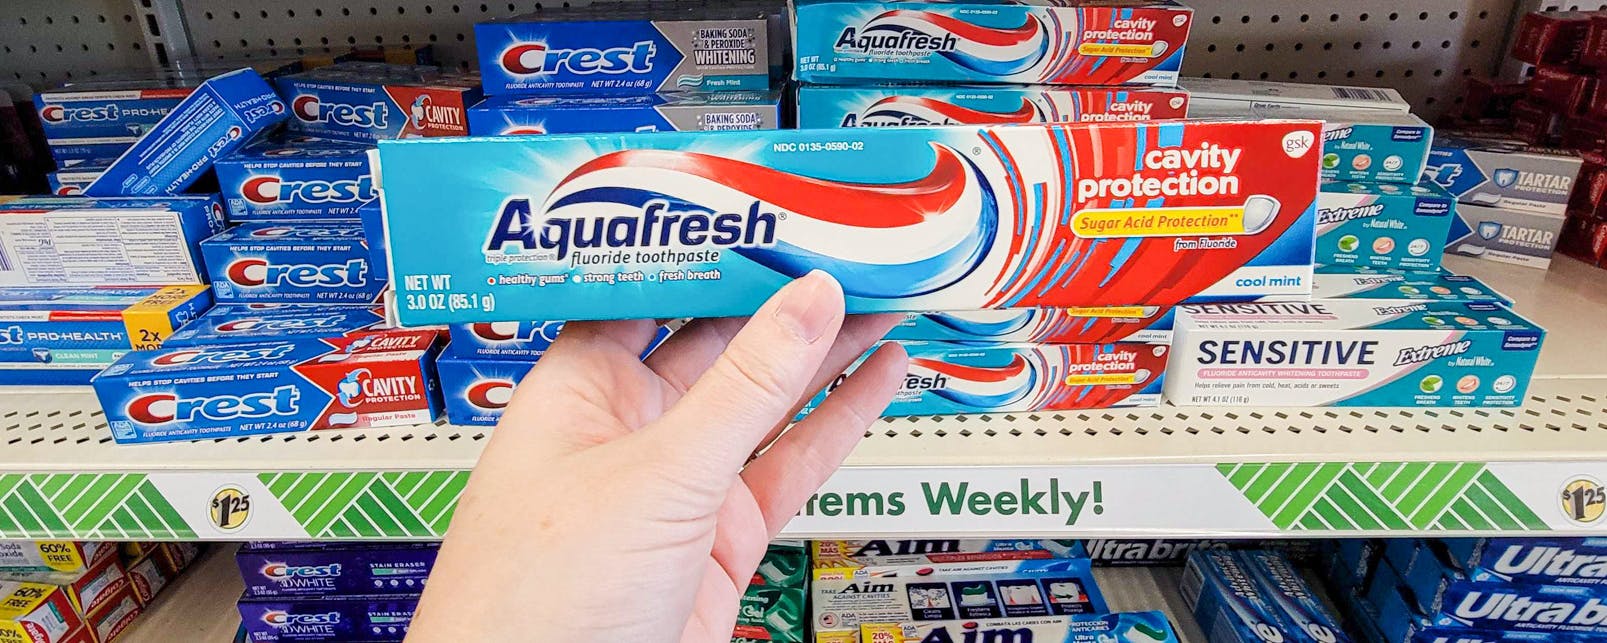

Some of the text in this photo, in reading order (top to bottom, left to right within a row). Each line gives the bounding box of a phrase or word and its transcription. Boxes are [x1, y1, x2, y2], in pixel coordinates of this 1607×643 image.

[1114, 16, 1156, 33] cavity
[700, 28, 748, 39] BAKING SODA
[834, 26, 957, 53] Aquafresh
[1083, 29, 1153, 42] protection
[711, 39, 745, 49] PEROXIDE
[501, 41, 656, 76] Crest
[694, 48, 756, 65] WHITENING
[591, 80, 616, 88] NET WT
[41, 104, 119, 124] Crest
[292, 94, 388, 129] Crest
[425, 105, 461, 125] CAVITY
[1111, 101, 1152, 117] cavity
[706, 114, 755, 124] BAKING SODA
[427, 123, 464, 132] PROTECTION
[207, 125, 243, 160] Crest
[773, 142, 864, 152] NDC 0135-0590-02
[1285, 136, 1309, 150] gsk
[1145, 141, 1242, 174] cavity
[1078, 172, 1239, 203] protection
[1517, 171, 1571, 190] TARTAR
[240, 174, 380, 206] Crest
[1515, 186, 1568, 195] PROTECTION
[328, 207, 339, 215] NET
[1317, 203, 1384, 225] Extreme
[1079, 216, 1120, 233] Sugar
[1123, 215, 1153, 229] Acid
[1501, 225, 1553, 245] TARTAR
[1174, 237, 1237, 252] from Fluoride
[1499, 239, 1550, 250] PROTECTION
[570, 249, 720, 268] fluoride toothpaste
[226, 257, 368, 288] Crest
[498, 274, 538, 286] healthy
[583, 273, 616, 285] strong
[617, 271, 644, 282] teeth
[659, 270, 686, 281] fresh
[687, 269, 721, 280] breath
[404, 274, 451, 291] NET WT
[1236, 275, 1301, 287] cool mint
[406, 292, 496, 312] 3.0 OZ (85.1 g)
[1183, 304, 1333, 315] SENSITIVE
[1373, 302, 1429, 316] Extreme
[139, 329, 162, 342] 2x
[371, 335, 421, 348] CAVITY
[151, 344, 295, 367] Crest
[1098, 350, 1138, 363] cavity
[1197, 340, 1379, 365] SENSITIVE
[1393, 340, 1472, 366] Extreme
[1069, 361, 1135, 373] protection
[1455, 356, 1475, 366] Natural
[173, 377, 205, 385] CAVITIES
[206, 375, 234, 383] BEFORE
[236, 373, 254, 381] THEY
[362, 376, 416, 397] CAVITY
[1194, 382, 1211, 390] Helps
[125, 385, 301, 426] Crest
[365, 394, 421, 403] PROTECTION
[142, 430, 167, 438] FLUORIDE
[168, 429, 199, 437] ANTICAVITY
[199, 426, 232, 434] TOOTHPASTE
[239, 423, 254, 431] NET
[254, 422, 267, 430] WT
[267, 421, 278, 429] 2.4
[287, 420, 299, 429] (68
[795, 477, 1104, 526] tems Weekly!
[40, 543, 71, 553] 60%
[48, 554, 73, 562] FREE
[1493, 544, 1607, 578] Ultra
[264, 563, 342, 578] Crest
[837, 581, 895, 594] Aim
[1555, 577, 1600, 585] ANTICAVITY
[14, 586, 47, 599] 60%
[5, 598, 34, 608] FREE
[1455, 591, 1576, 623] Ultra
[264, 612, 341, 626] Crest
[1513, 622, 1558, 630] ANTICAVITY
[872, 631, 894, 641] 20%
